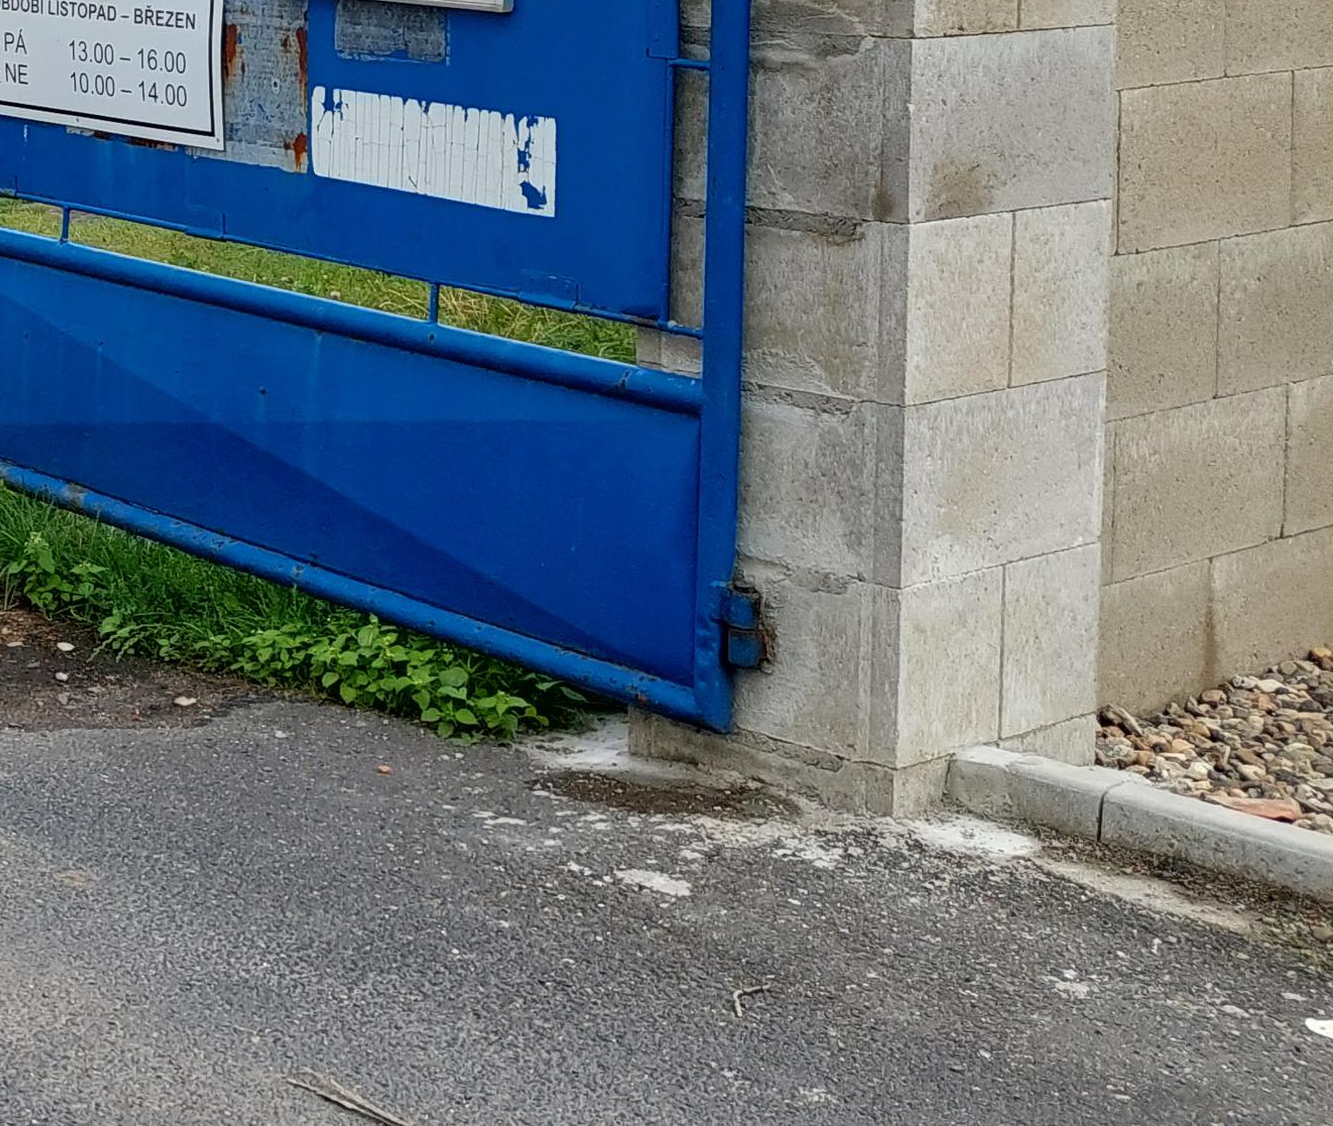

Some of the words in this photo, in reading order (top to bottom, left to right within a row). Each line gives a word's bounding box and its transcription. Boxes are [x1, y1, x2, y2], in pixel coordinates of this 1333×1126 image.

[48, 0, 117, 22] LISTOPAD
[134, 5, 196, 30] BŘEZEN
[4, 29, 27, 55] PÁ
[69, 40, 114, 65] 13.00
[137, 48, 186, 74] 16.00
[5, 63, 29, 85] NE
[70, 72, 115, 97] 10.00
[138, 81, 187, 107] 14.00
